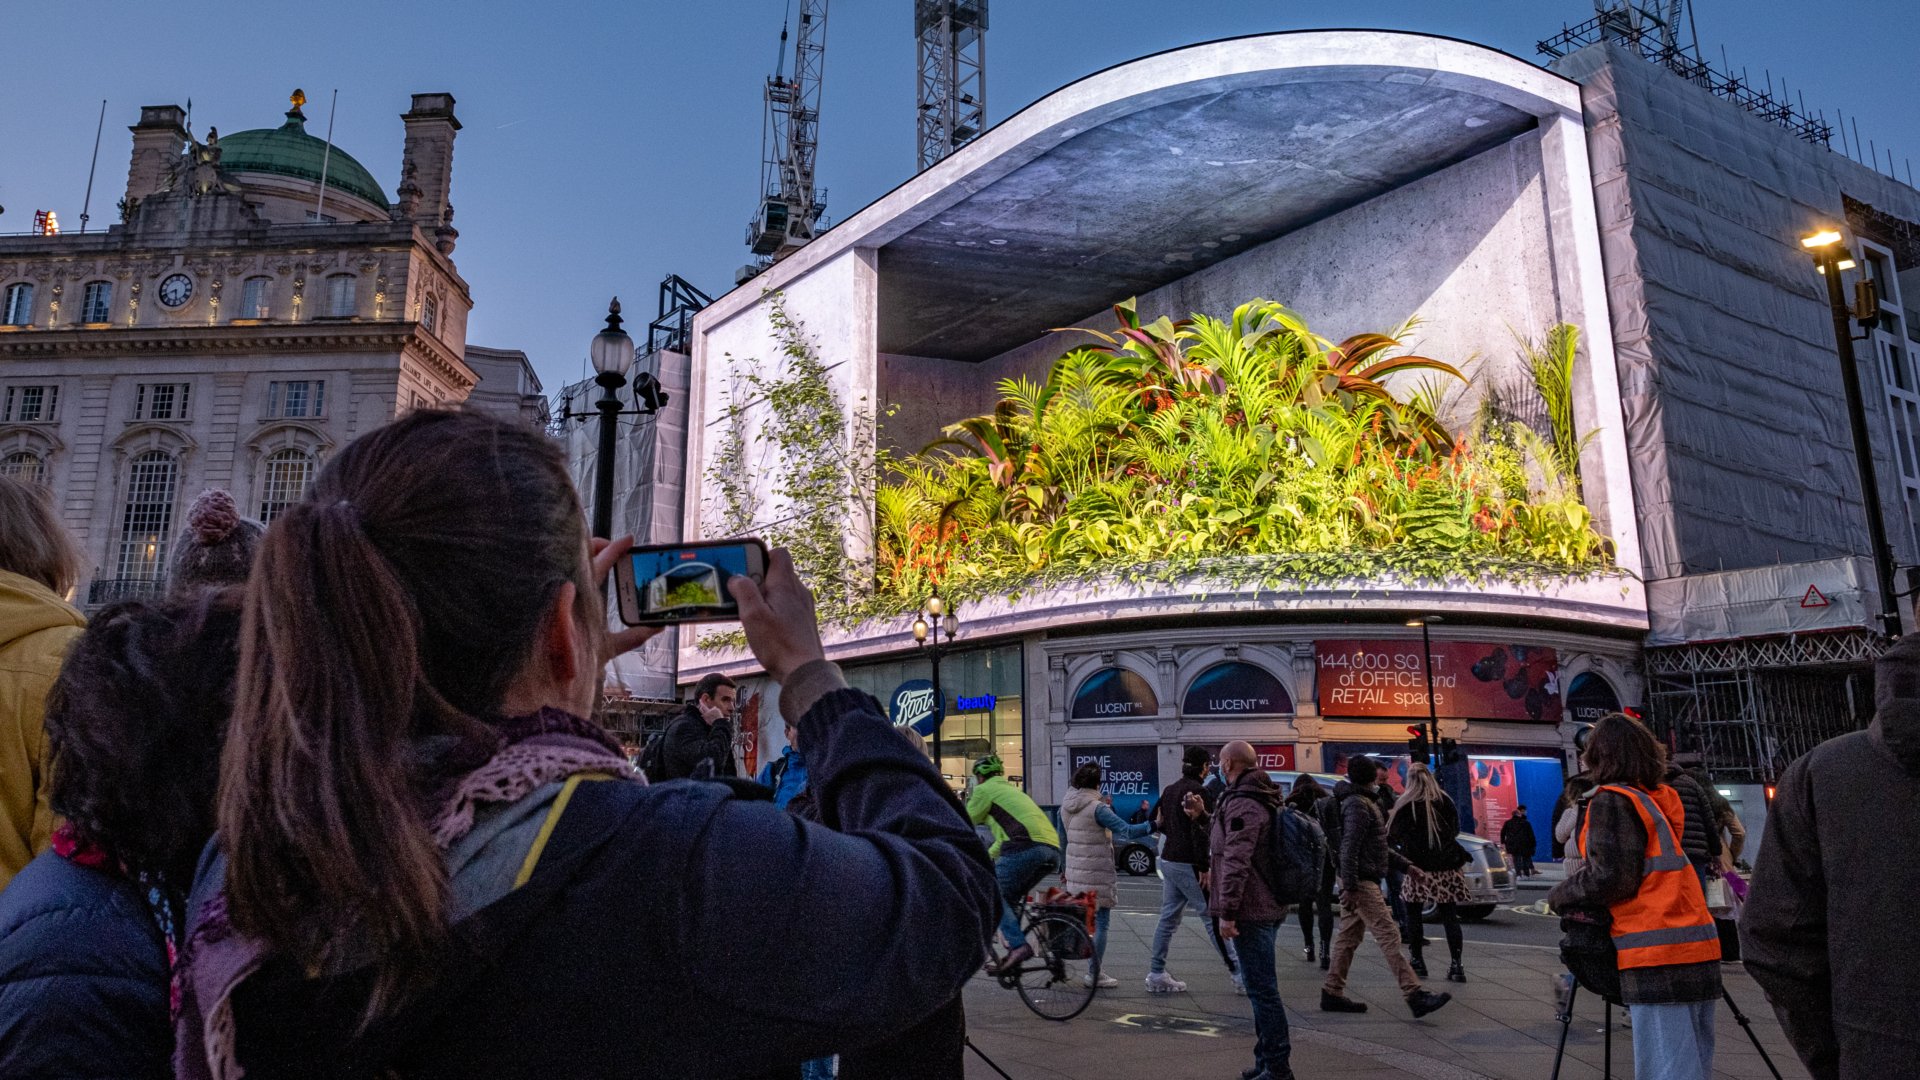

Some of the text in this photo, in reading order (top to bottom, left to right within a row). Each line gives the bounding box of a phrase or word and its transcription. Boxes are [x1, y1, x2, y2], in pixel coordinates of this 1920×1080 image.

[1318, 653, 1390, 671] 144,000
[1394, 653, 1420, 670] SQ
[1339, 671, 1355, 687] of
[1360, 671, 1423, 687] OFFICE
[957, 693, 997, 711] beauty
[1209, 698, 1257, 710] LUCENT
[1331, 688, 1444, 708] RETAIL space
[1095, 702, 1133, 714] LUCENT
[1109, 771, 1143, 784] space
